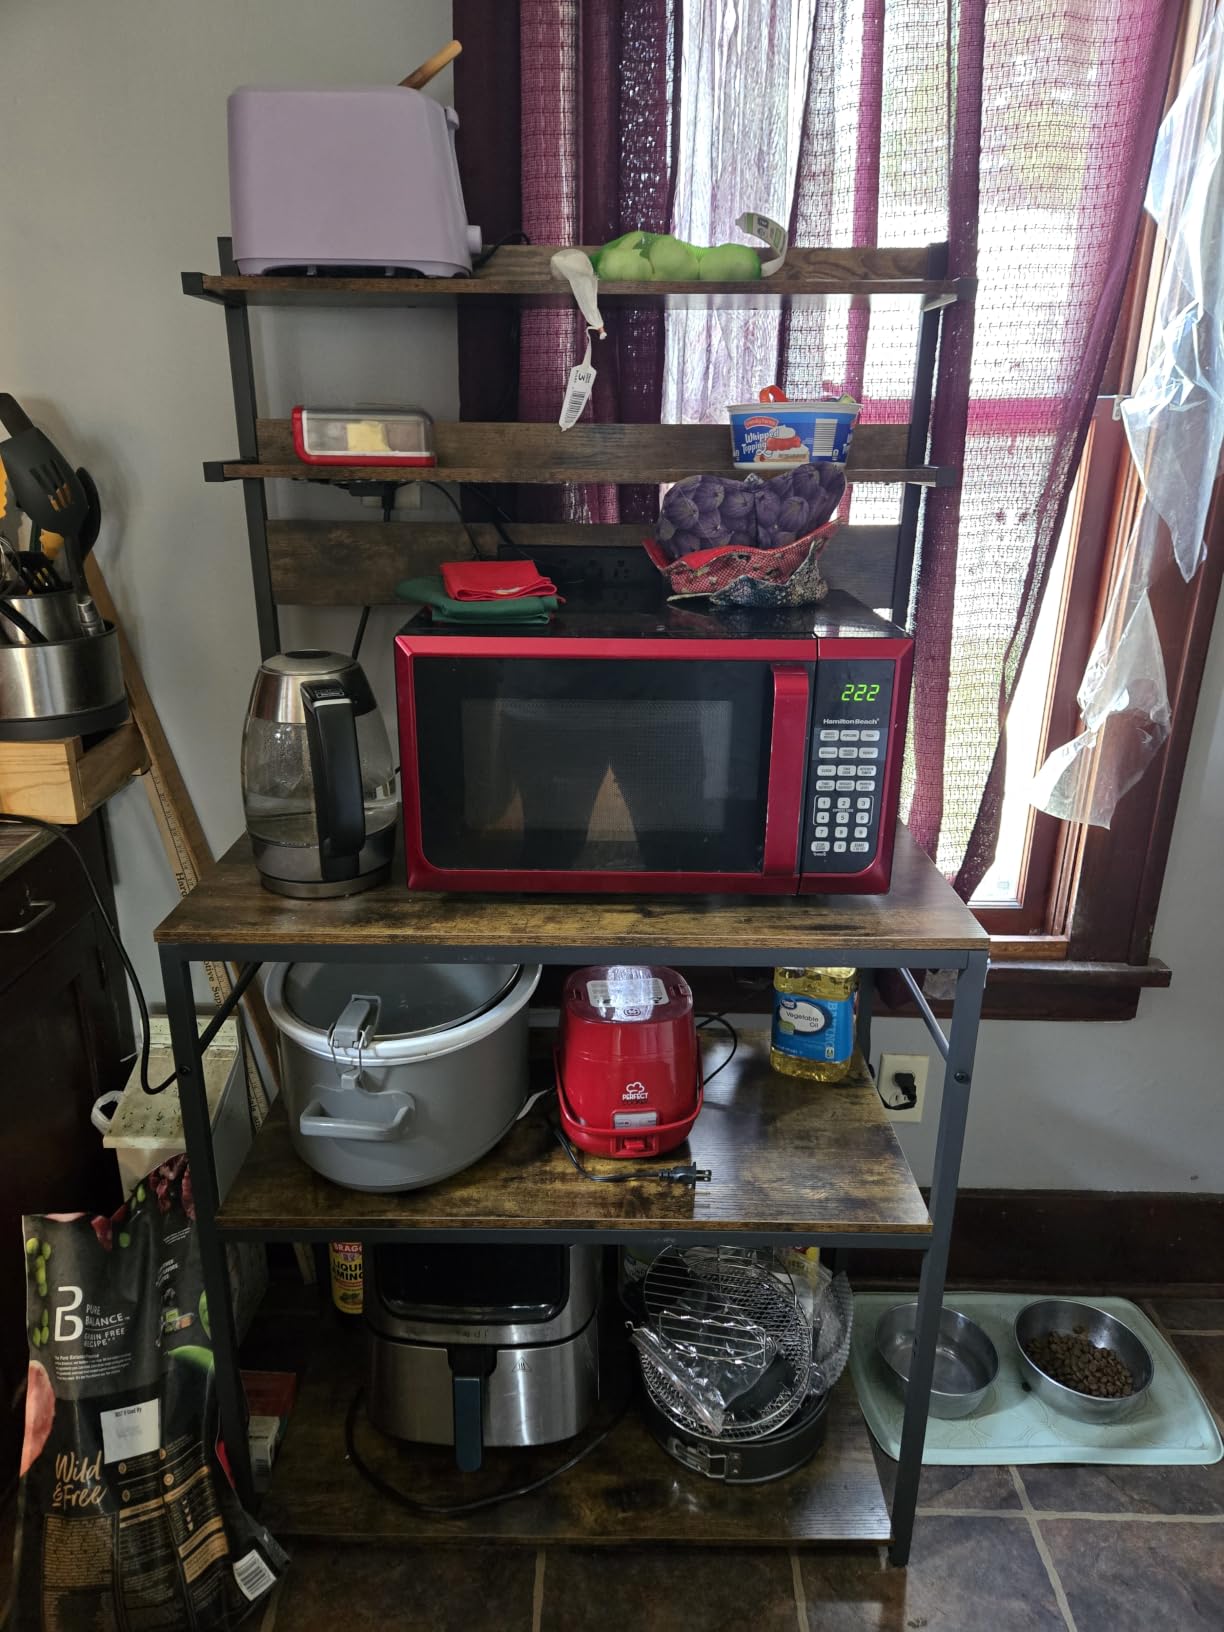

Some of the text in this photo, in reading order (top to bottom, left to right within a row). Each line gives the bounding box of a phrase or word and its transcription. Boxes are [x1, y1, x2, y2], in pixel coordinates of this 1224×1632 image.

[745, 429, 780, 444] Whipped
[841, 683, 880, 702] 222
[786, 1011, 819, 1022] Vegetable
[104, 1327, 125, 1339] FREE
[55, 1450, 102, 1483] Wild
[63, 1484, 107, 1511] Free
